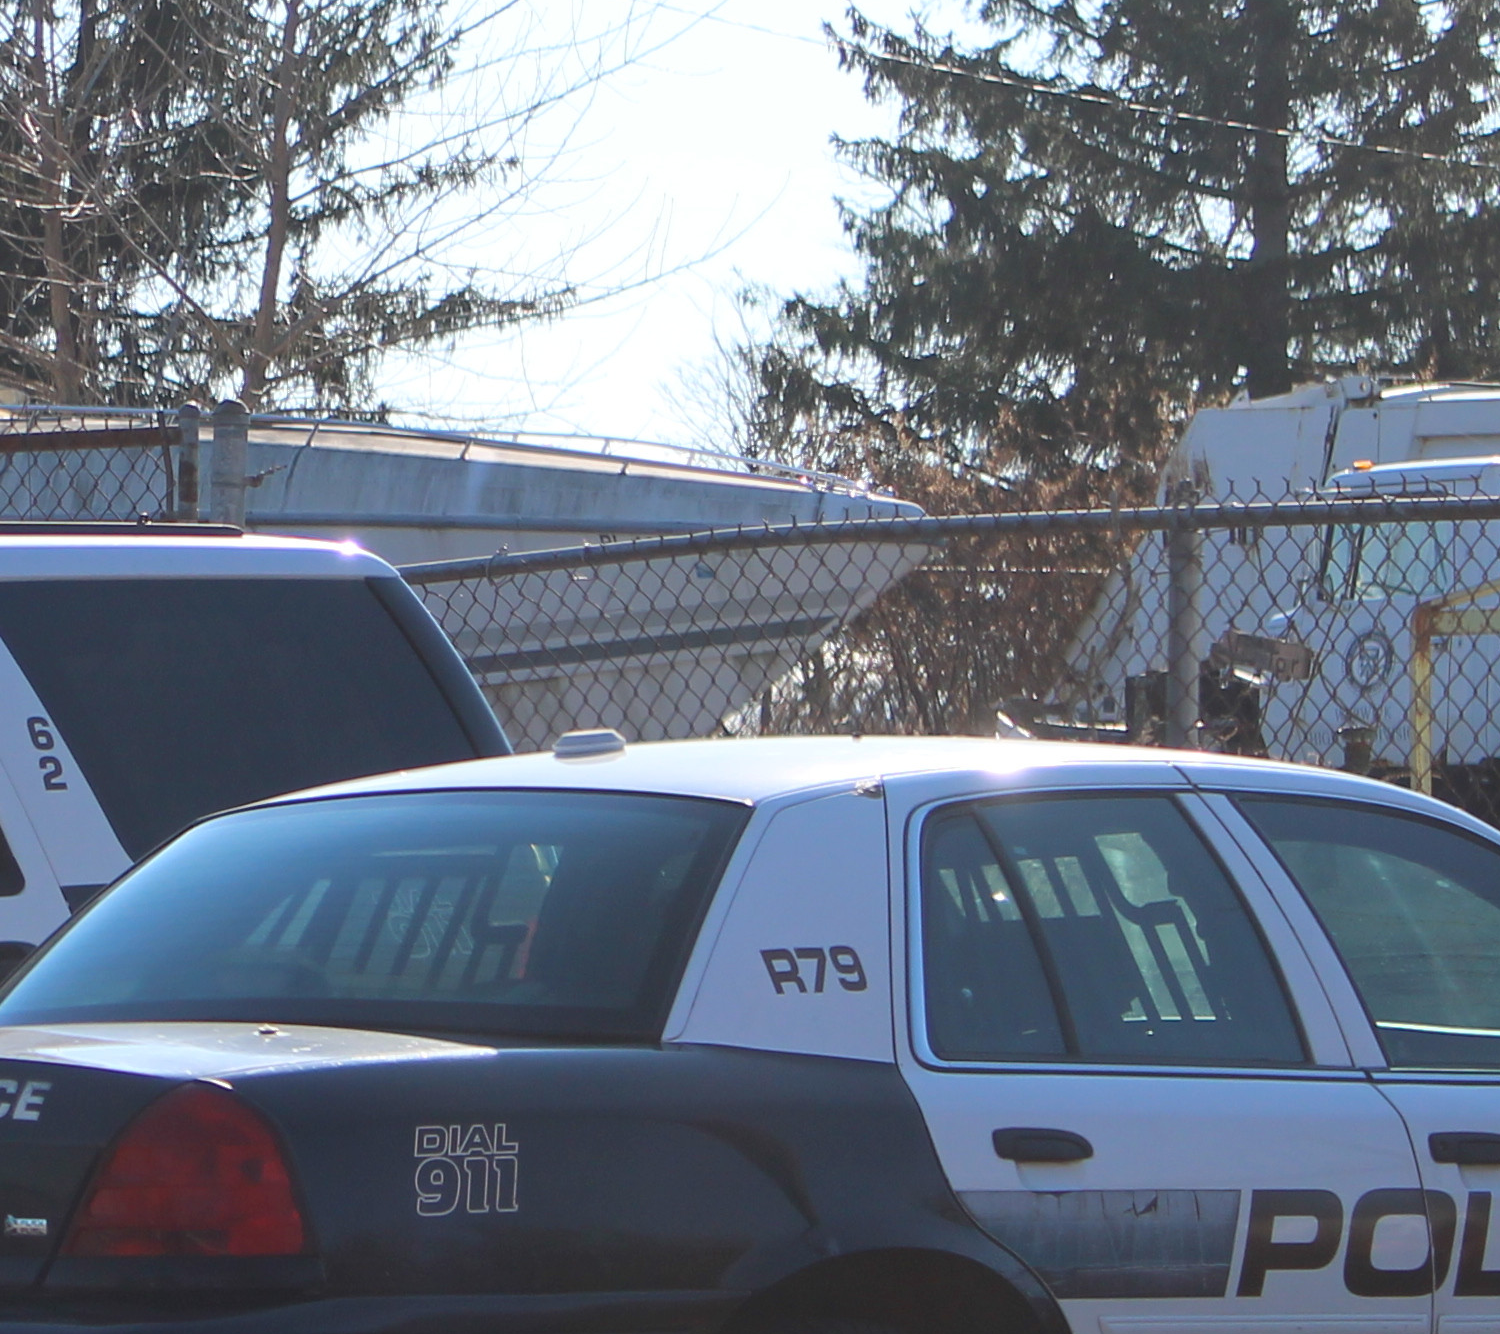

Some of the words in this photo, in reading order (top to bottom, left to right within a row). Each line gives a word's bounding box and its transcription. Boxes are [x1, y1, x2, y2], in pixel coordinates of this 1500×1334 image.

[759, 945, 868, 995] R79
[413, 1123, 519, 1157] DIAL
[414, 1156, 519, 1217] 911
